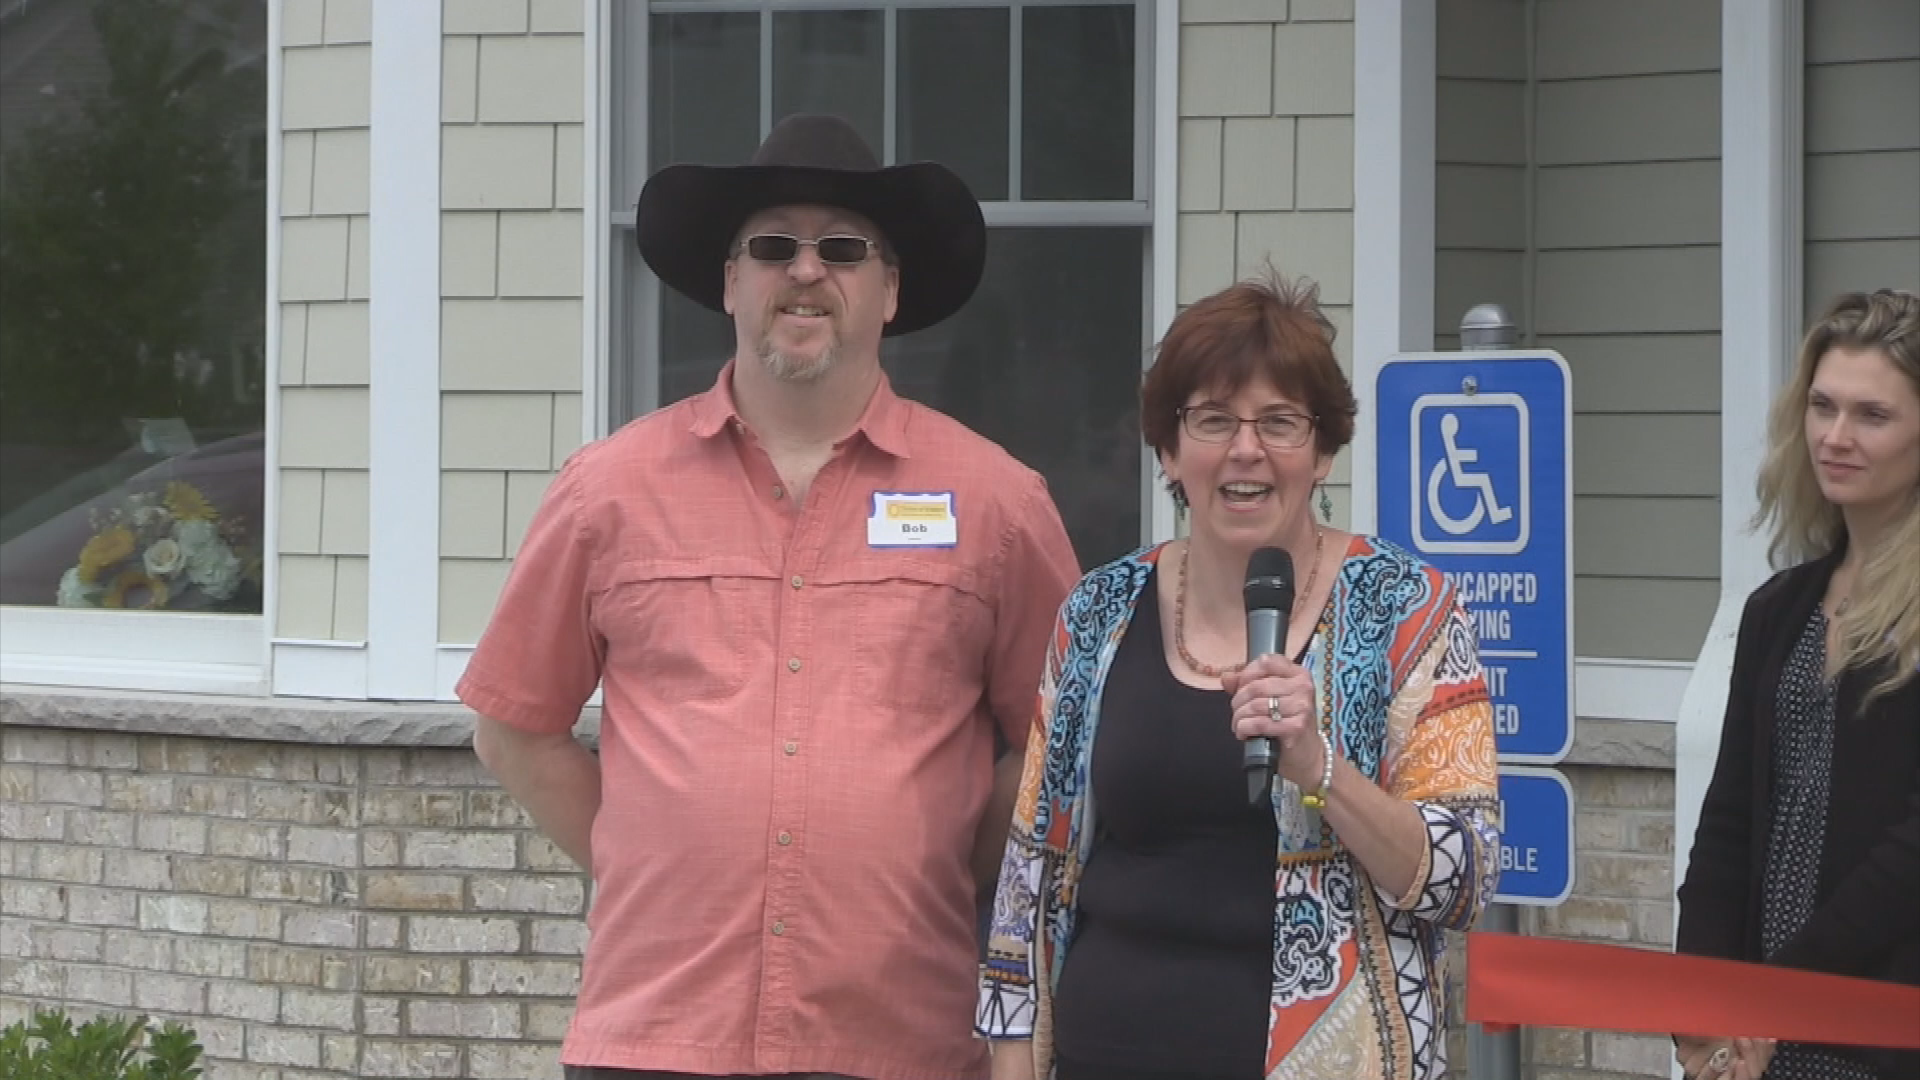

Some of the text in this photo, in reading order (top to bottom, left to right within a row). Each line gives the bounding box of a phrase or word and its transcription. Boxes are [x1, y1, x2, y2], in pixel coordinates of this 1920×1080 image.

[901, 523, 928, 533] Bob
[1483, 666, 1508, 697] IT
[1500, 845, 1539, 873] BLE
